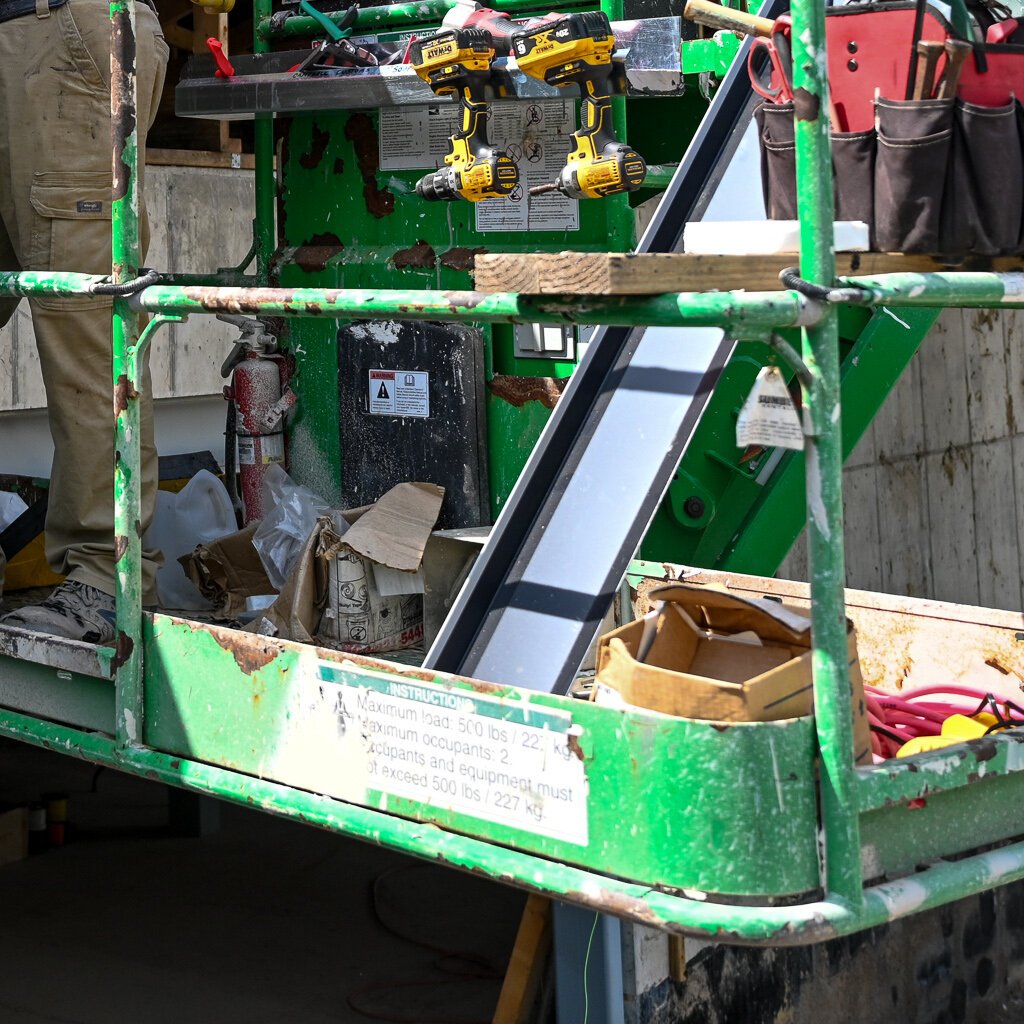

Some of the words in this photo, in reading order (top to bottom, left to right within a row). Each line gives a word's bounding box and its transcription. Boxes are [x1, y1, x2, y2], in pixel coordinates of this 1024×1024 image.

[357, 694, 417, 722] Maximum
[458, 717, 483, 736] 500
[488, 724, 508, 743] lbs
[382, 765, 428, 788] exceed
[432, 776, 457, 796] 500
[462, 783, 481, 802] lbs
[494, 791, 520, 812] 227
[430, 756, 454, 773] and
[459, 763, 532, 792] equipment
[537, 783, 573, 802] must
